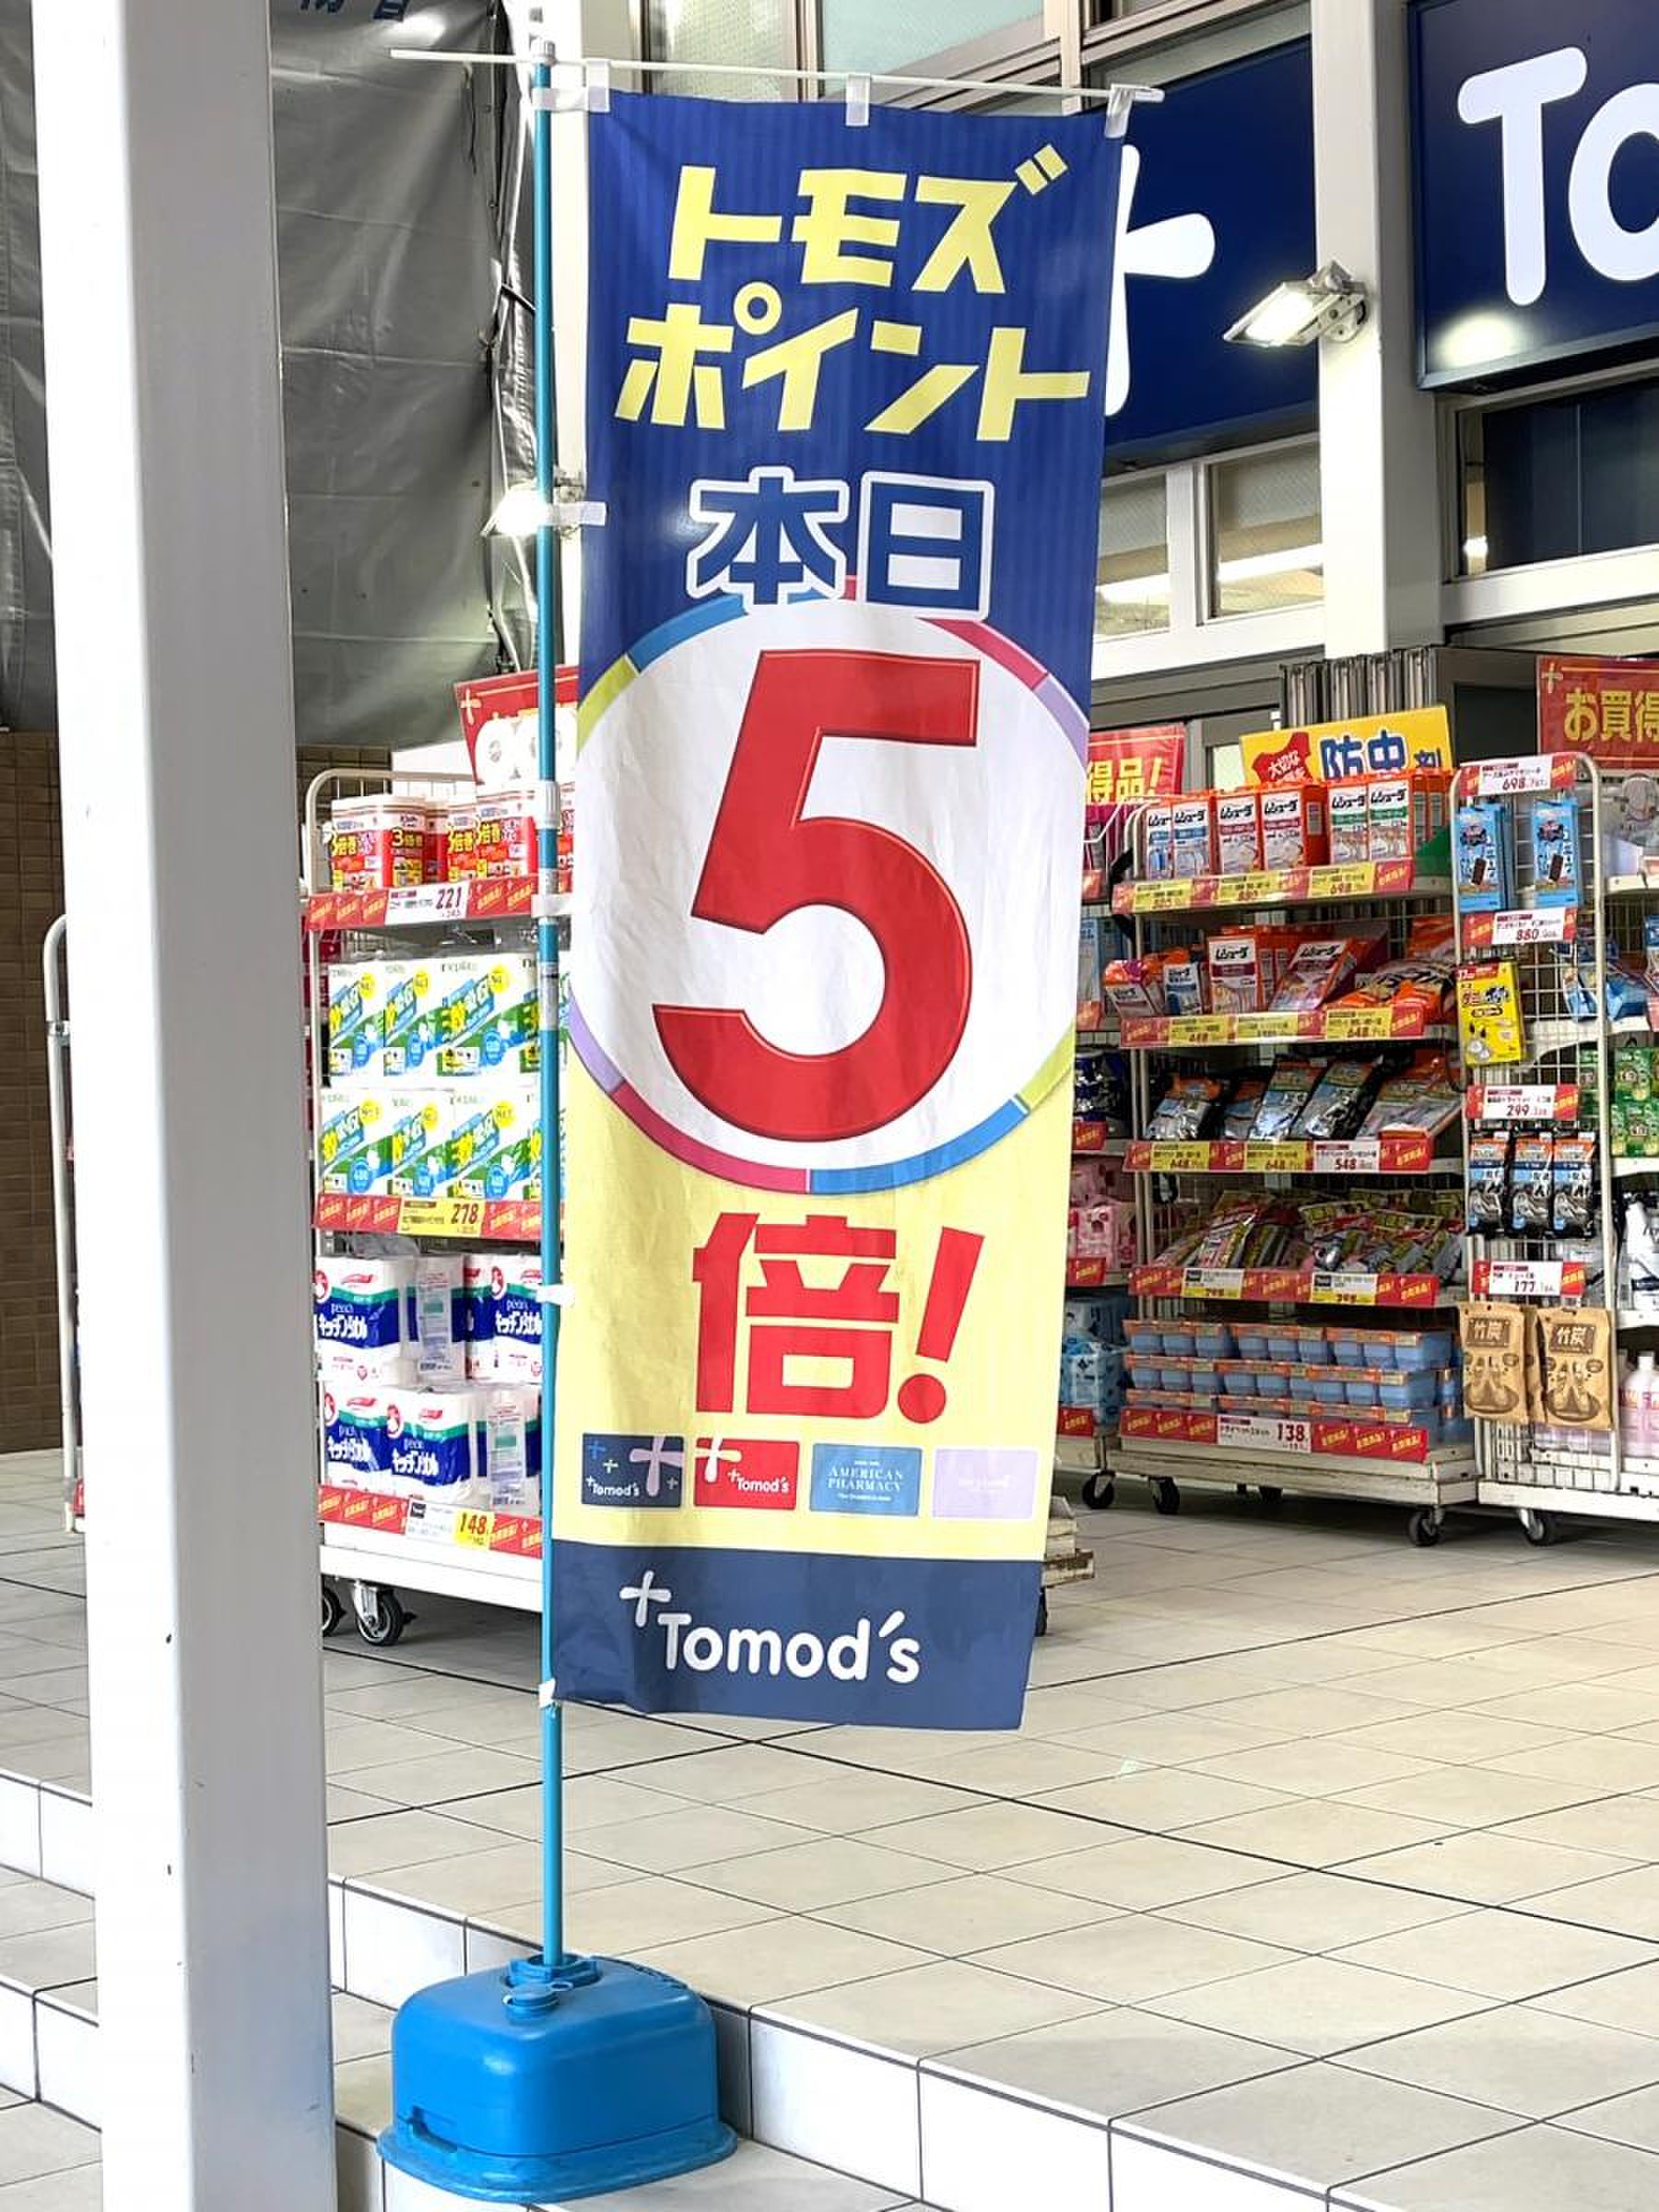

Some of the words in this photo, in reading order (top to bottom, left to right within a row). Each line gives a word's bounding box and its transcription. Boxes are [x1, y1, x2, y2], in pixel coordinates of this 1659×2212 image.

[1458, 47, 1659, 306] To
[668, 144, 1068, 293] トモズ
[615, 281, 1090, 441] ポイント
[688, 467, 994, 618] 本日
[435, 887, 462, 910] 221
[653, 649, 979, 1142] 5
[1507, 1104, 1530, 1116] 299
[1335, 1159, 1356, 1171] 548
[451, 1202, 478, 1225] 278
[1514, 1280, 1536, 1293] 177
[692, 1212, 984, 1424] 倍!
[1474, 1321, 1502, 1340] 竹炭
[1557, 1326, 1586, 1347] 竹炭
[1277, 1424, 1305, 1442] 138
[828, 1465, 904, 1480] AMERICAN
[592, 1482, 640, 1497] Tomod's
[737, 1477, 790, 1493] Tomod's
[827, 1477, 902, 1492] PHARMACY
[459, 1512, 487, 1535] 148
[658, 1610, 920, 1683] Tomod's
